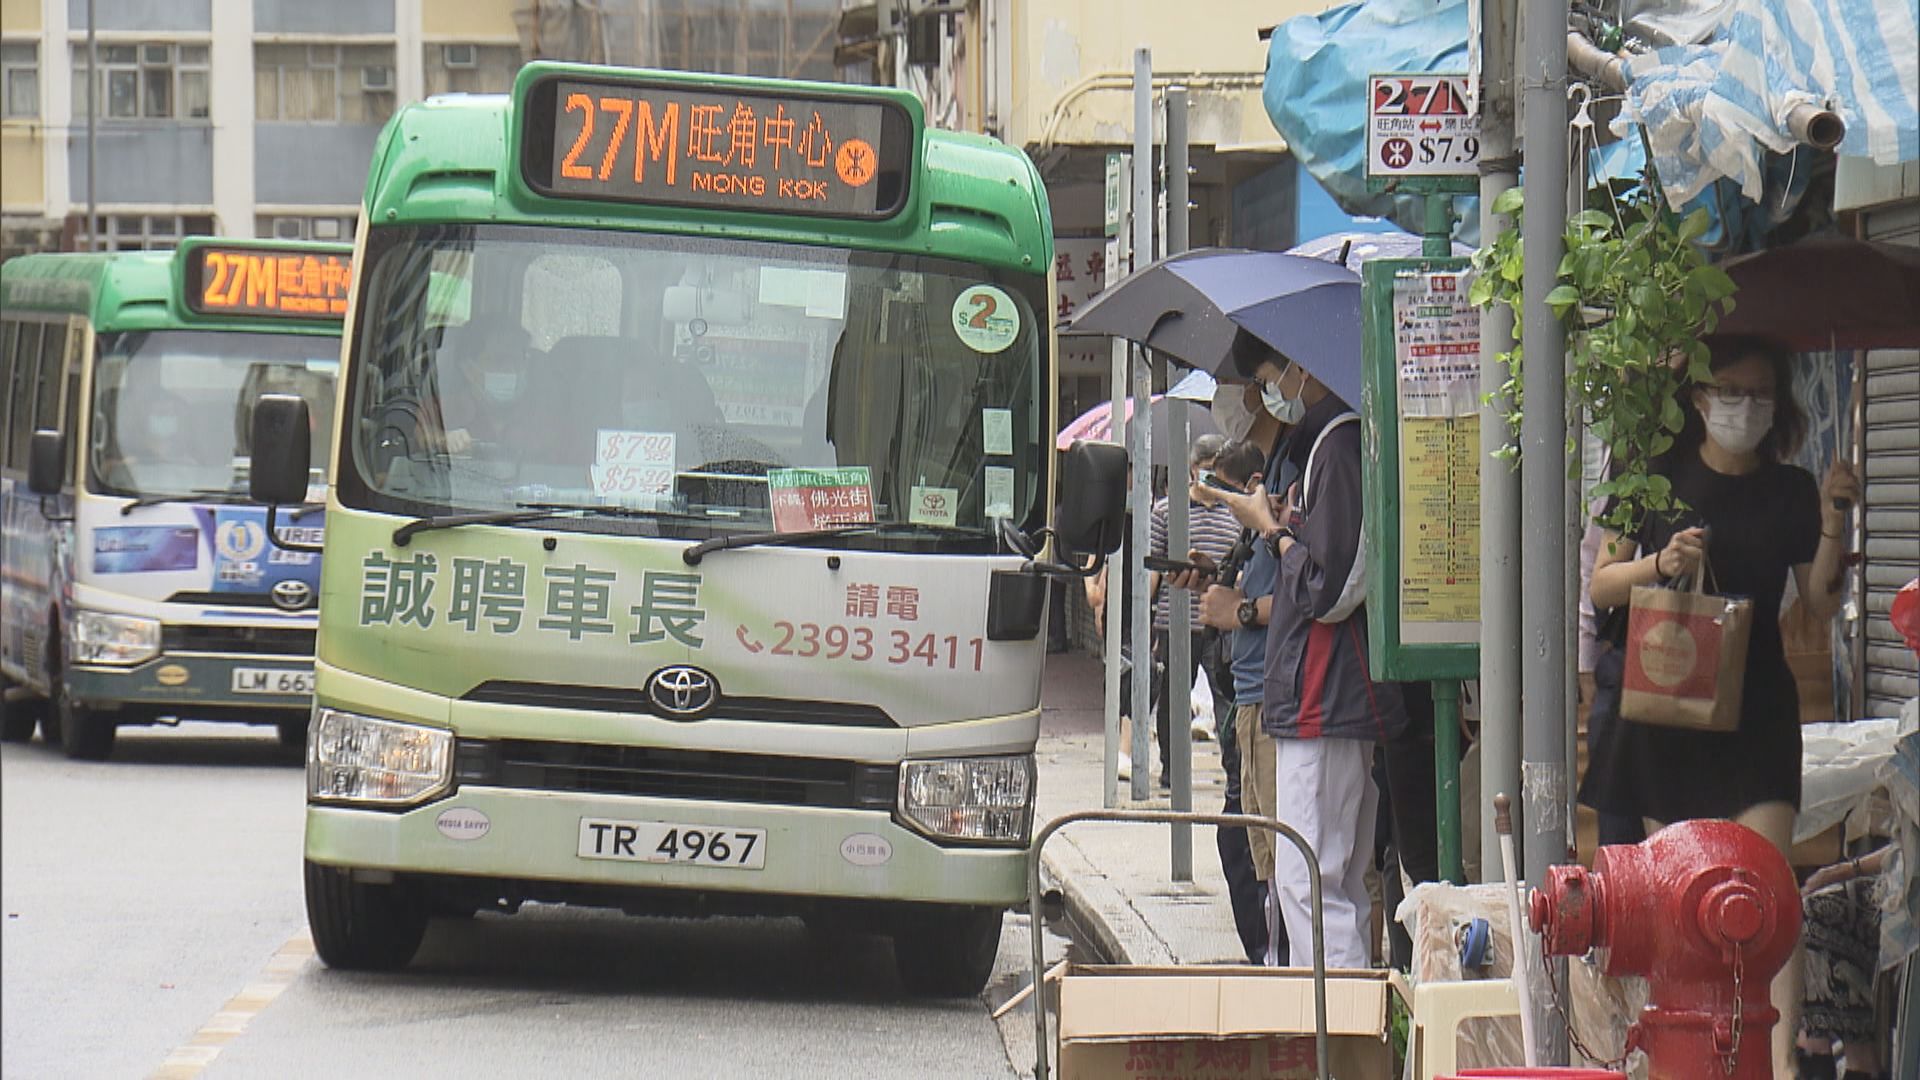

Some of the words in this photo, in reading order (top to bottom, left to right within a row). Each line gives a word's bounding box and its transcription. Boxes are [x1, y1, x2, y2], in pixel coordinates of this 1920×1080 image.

[561, 93, 680, 185] 27M
[687, 101, 833, 170] 旺角中心
[1418, 136, 1480, 165] $7.9
[691, 172, 767, 196] MONG
[778, 176, 829, 201] KOK
[203, 251, 278, 309] 27M
[809, 487, 868, 508] 佛光街
[918, 508, 949, 518] TOYOTA
[358, 549, 706, 649] 誠聘車長
[845, 582, 920, 621] 請電
[770, 621, 875, 661] 2393
[887, 629, 984, 672] 3411
[237, 671, 268, 690] LM
[587, 823, 638, 857] TR
[655, 827, 759, 865] 4967
